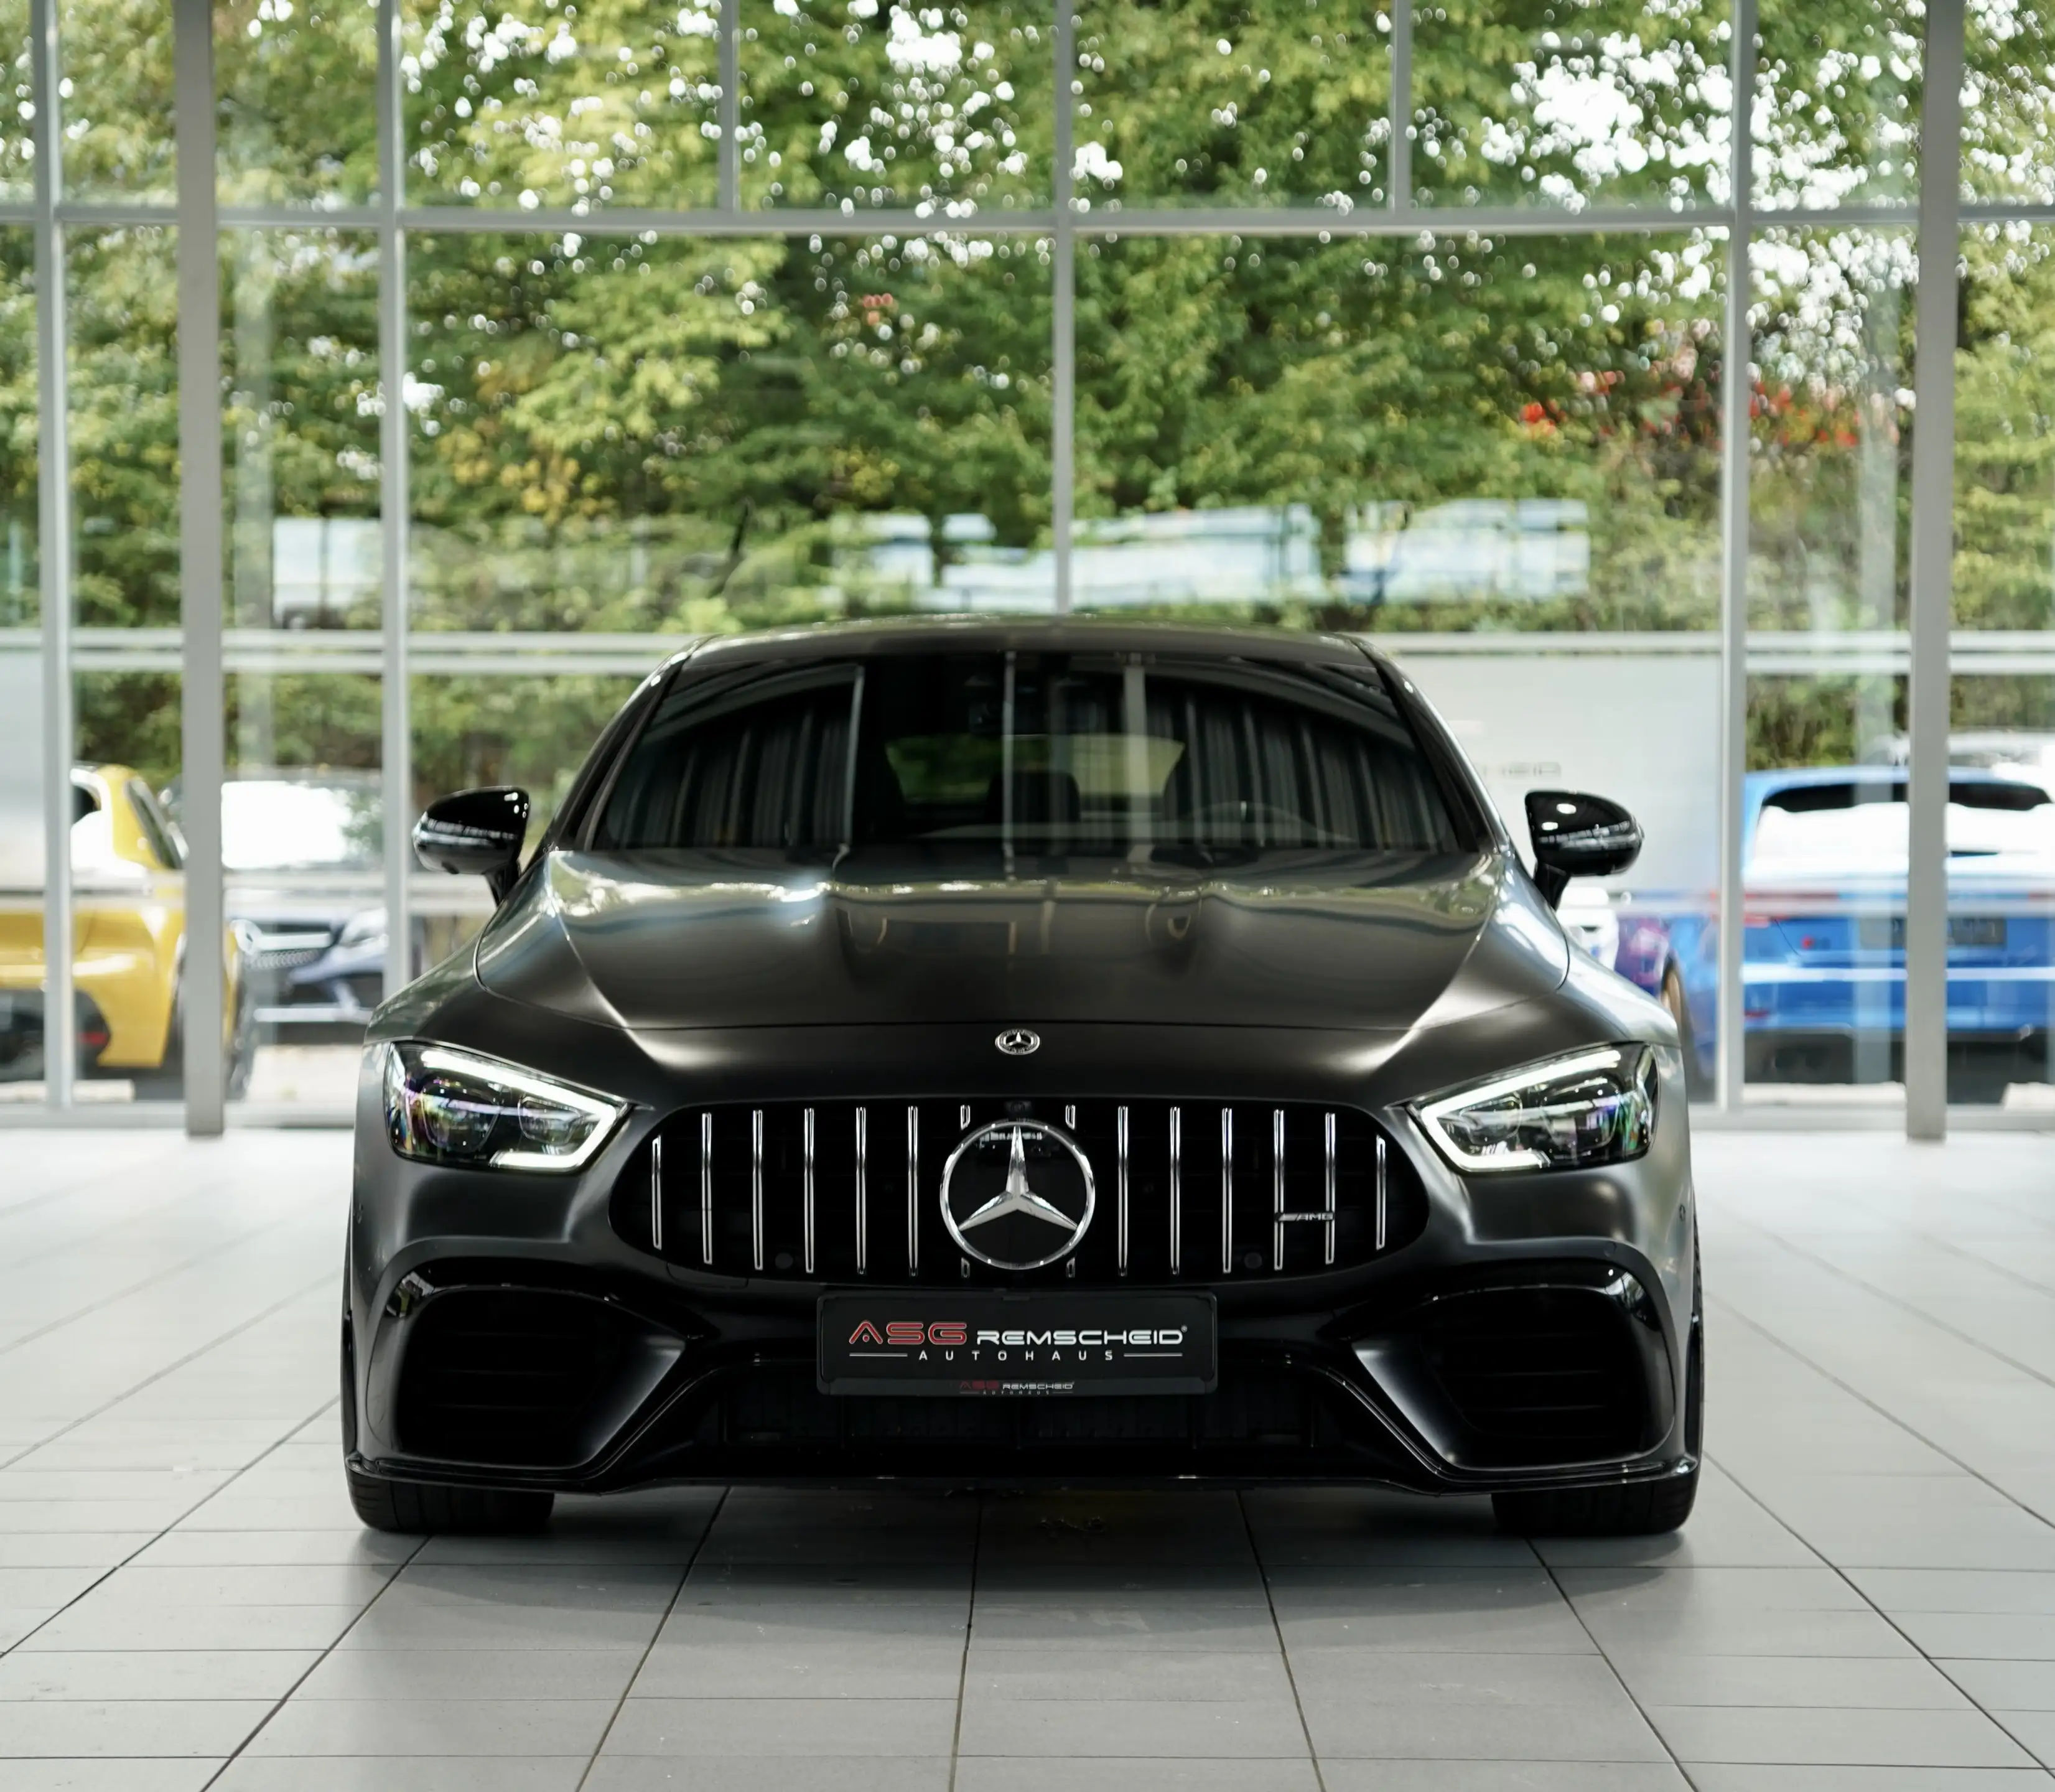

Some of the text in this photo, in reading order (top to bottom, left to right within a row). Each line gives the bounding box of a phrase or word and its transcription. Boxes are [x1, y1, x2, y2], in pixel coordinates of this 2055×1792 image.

[1297, 1213, 1333, 1221] AMG
[849, 1320, 967, 1345] ASG
[918, 1350, 1113, 1361] AUTOHAUS
